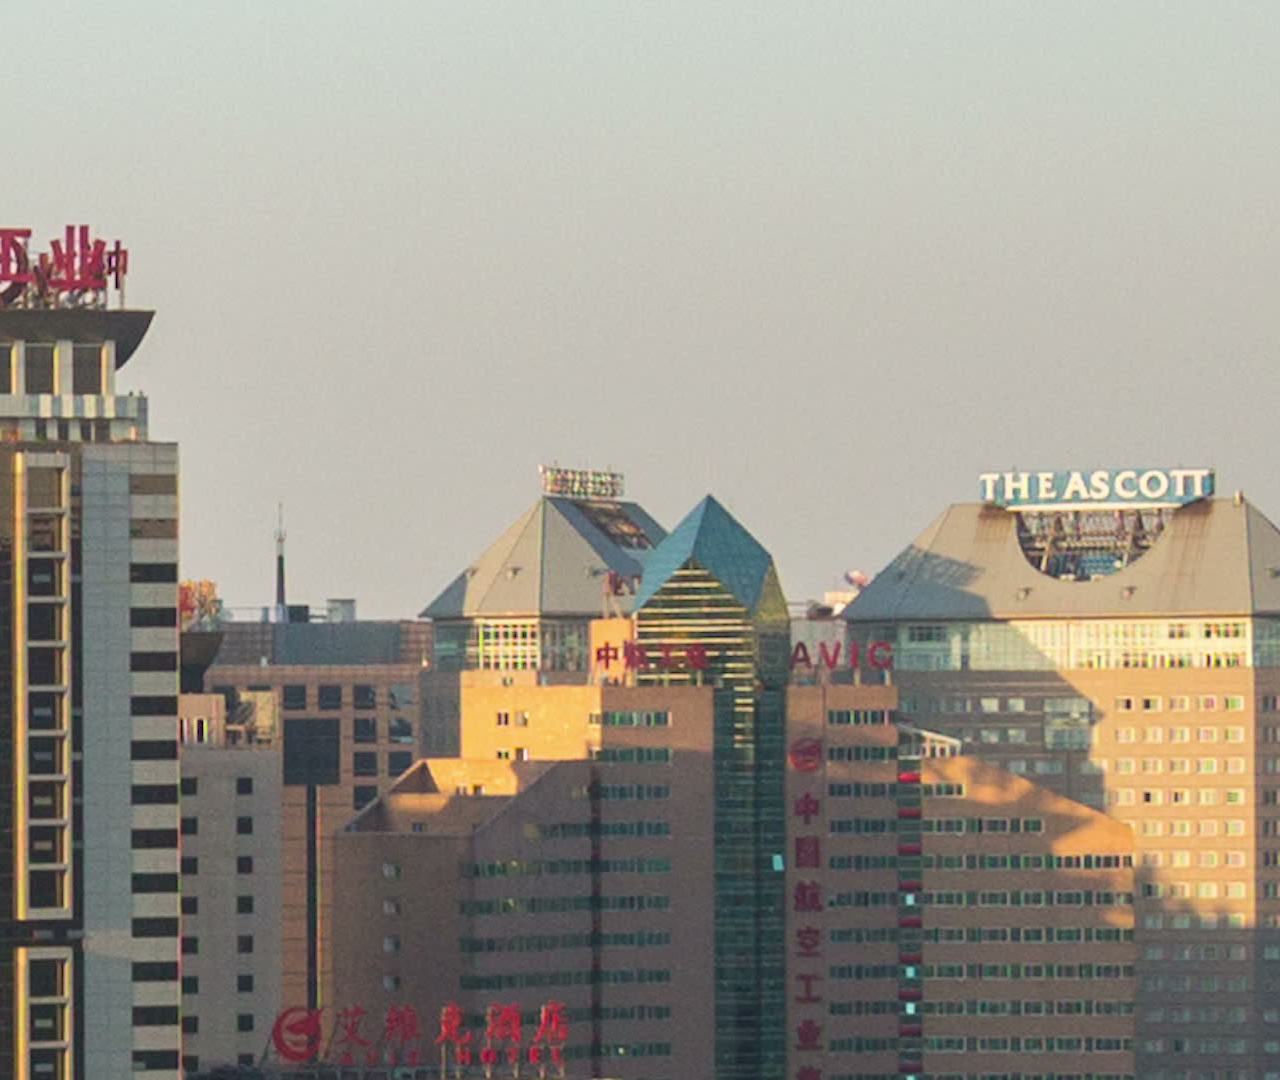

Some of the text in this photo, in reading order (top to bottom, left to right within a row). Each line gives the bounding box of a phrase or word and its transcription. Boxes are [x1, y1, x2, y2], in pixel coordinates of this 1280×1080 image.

[979, 469, 1209, 500] THE ASCOTT
[789, 640, 894, 671] AVIC
